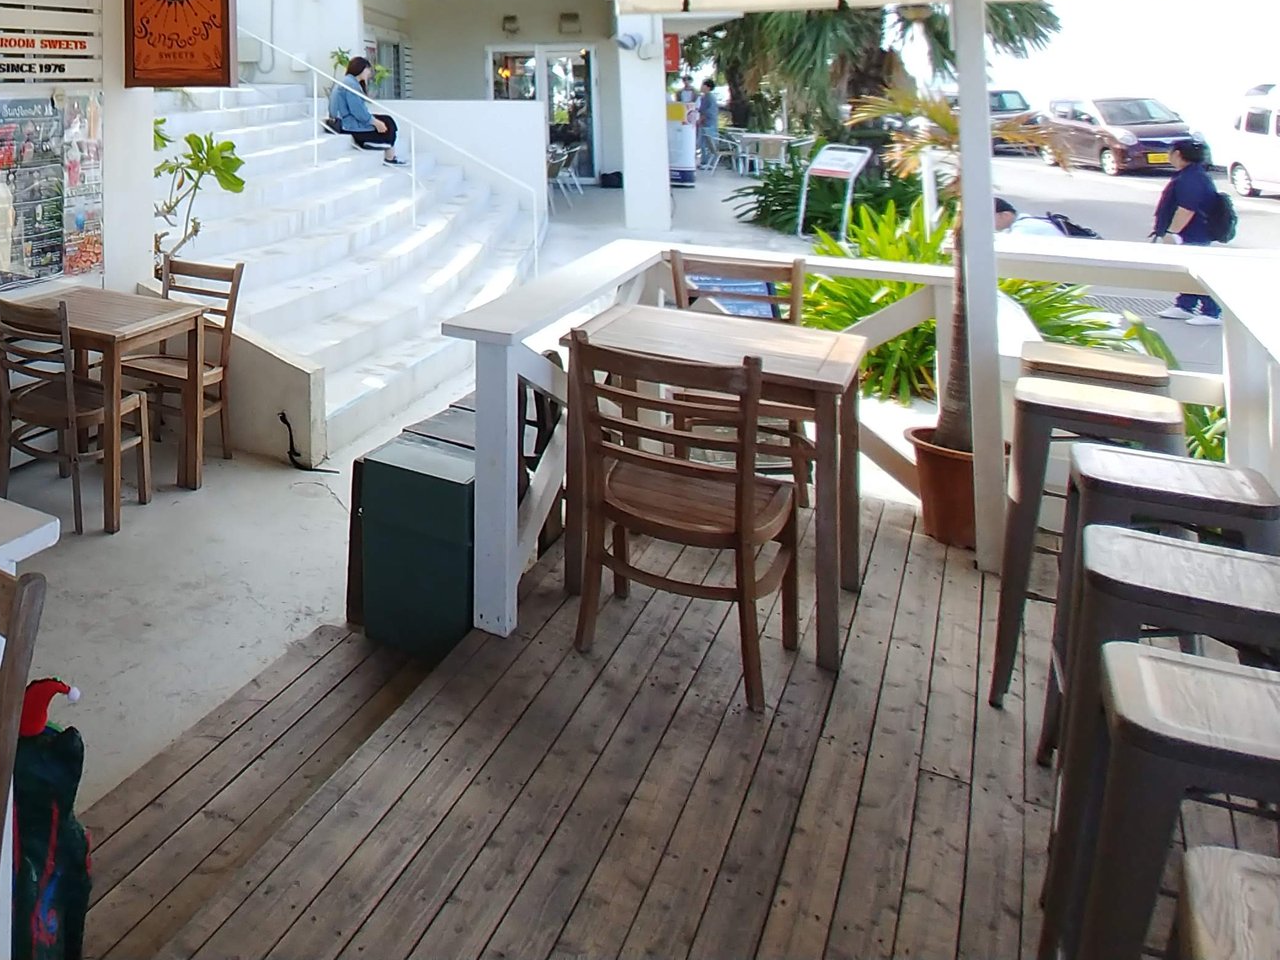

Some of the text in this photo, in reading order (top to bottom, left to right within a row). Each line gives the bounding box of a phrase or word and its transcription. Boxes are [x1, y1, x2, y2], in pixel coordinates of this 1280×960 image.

[40, 39, 88, 50] SWEETS
[159, 51, 196, 59] SWEETS
[39, 63, 66, 73] 1976
